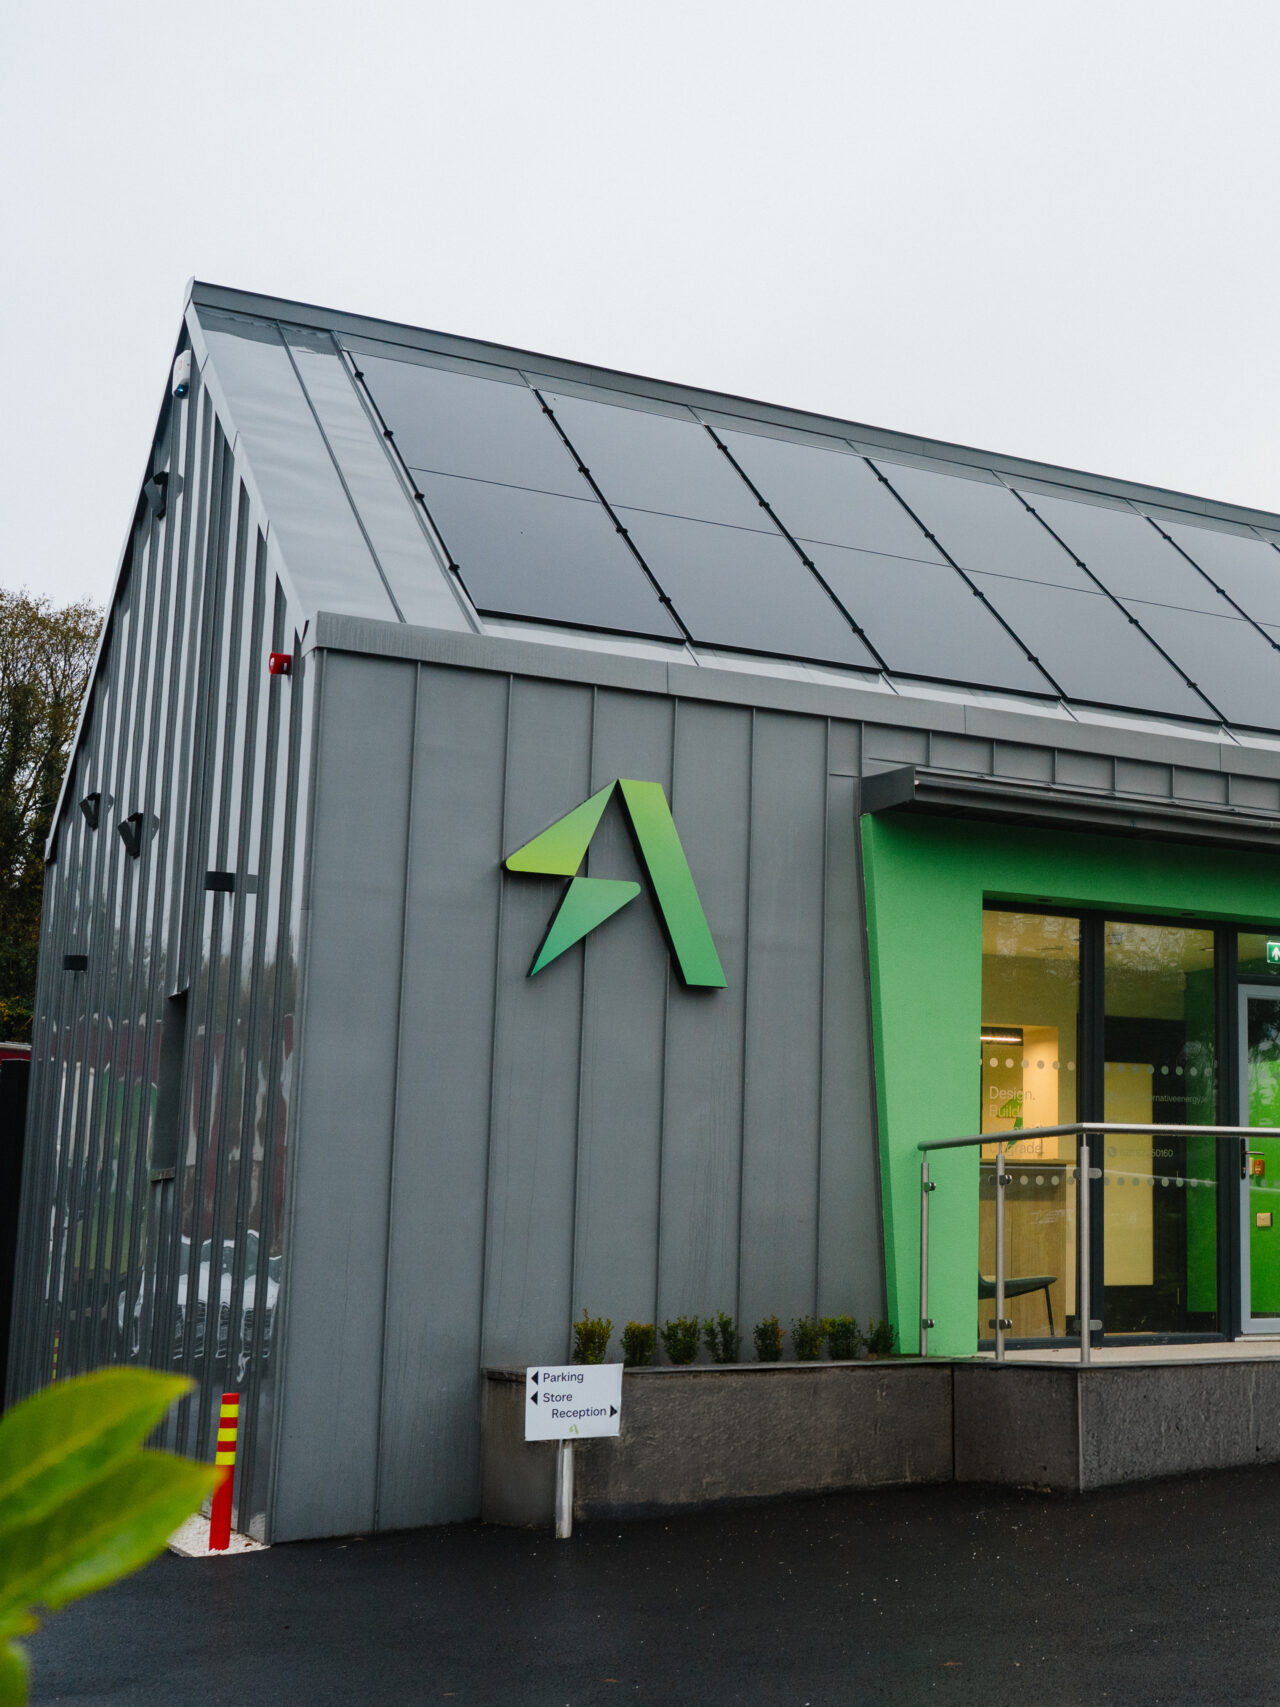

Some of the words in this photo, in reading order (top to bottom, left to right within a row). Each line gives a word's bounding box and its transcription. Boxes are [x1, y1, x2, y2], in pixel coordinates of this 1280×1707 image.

[543, 1372, 584, 1384] Parking
[542, 1392, 573, 1403] Store
[551, 1407, 607, 1420] Reception
